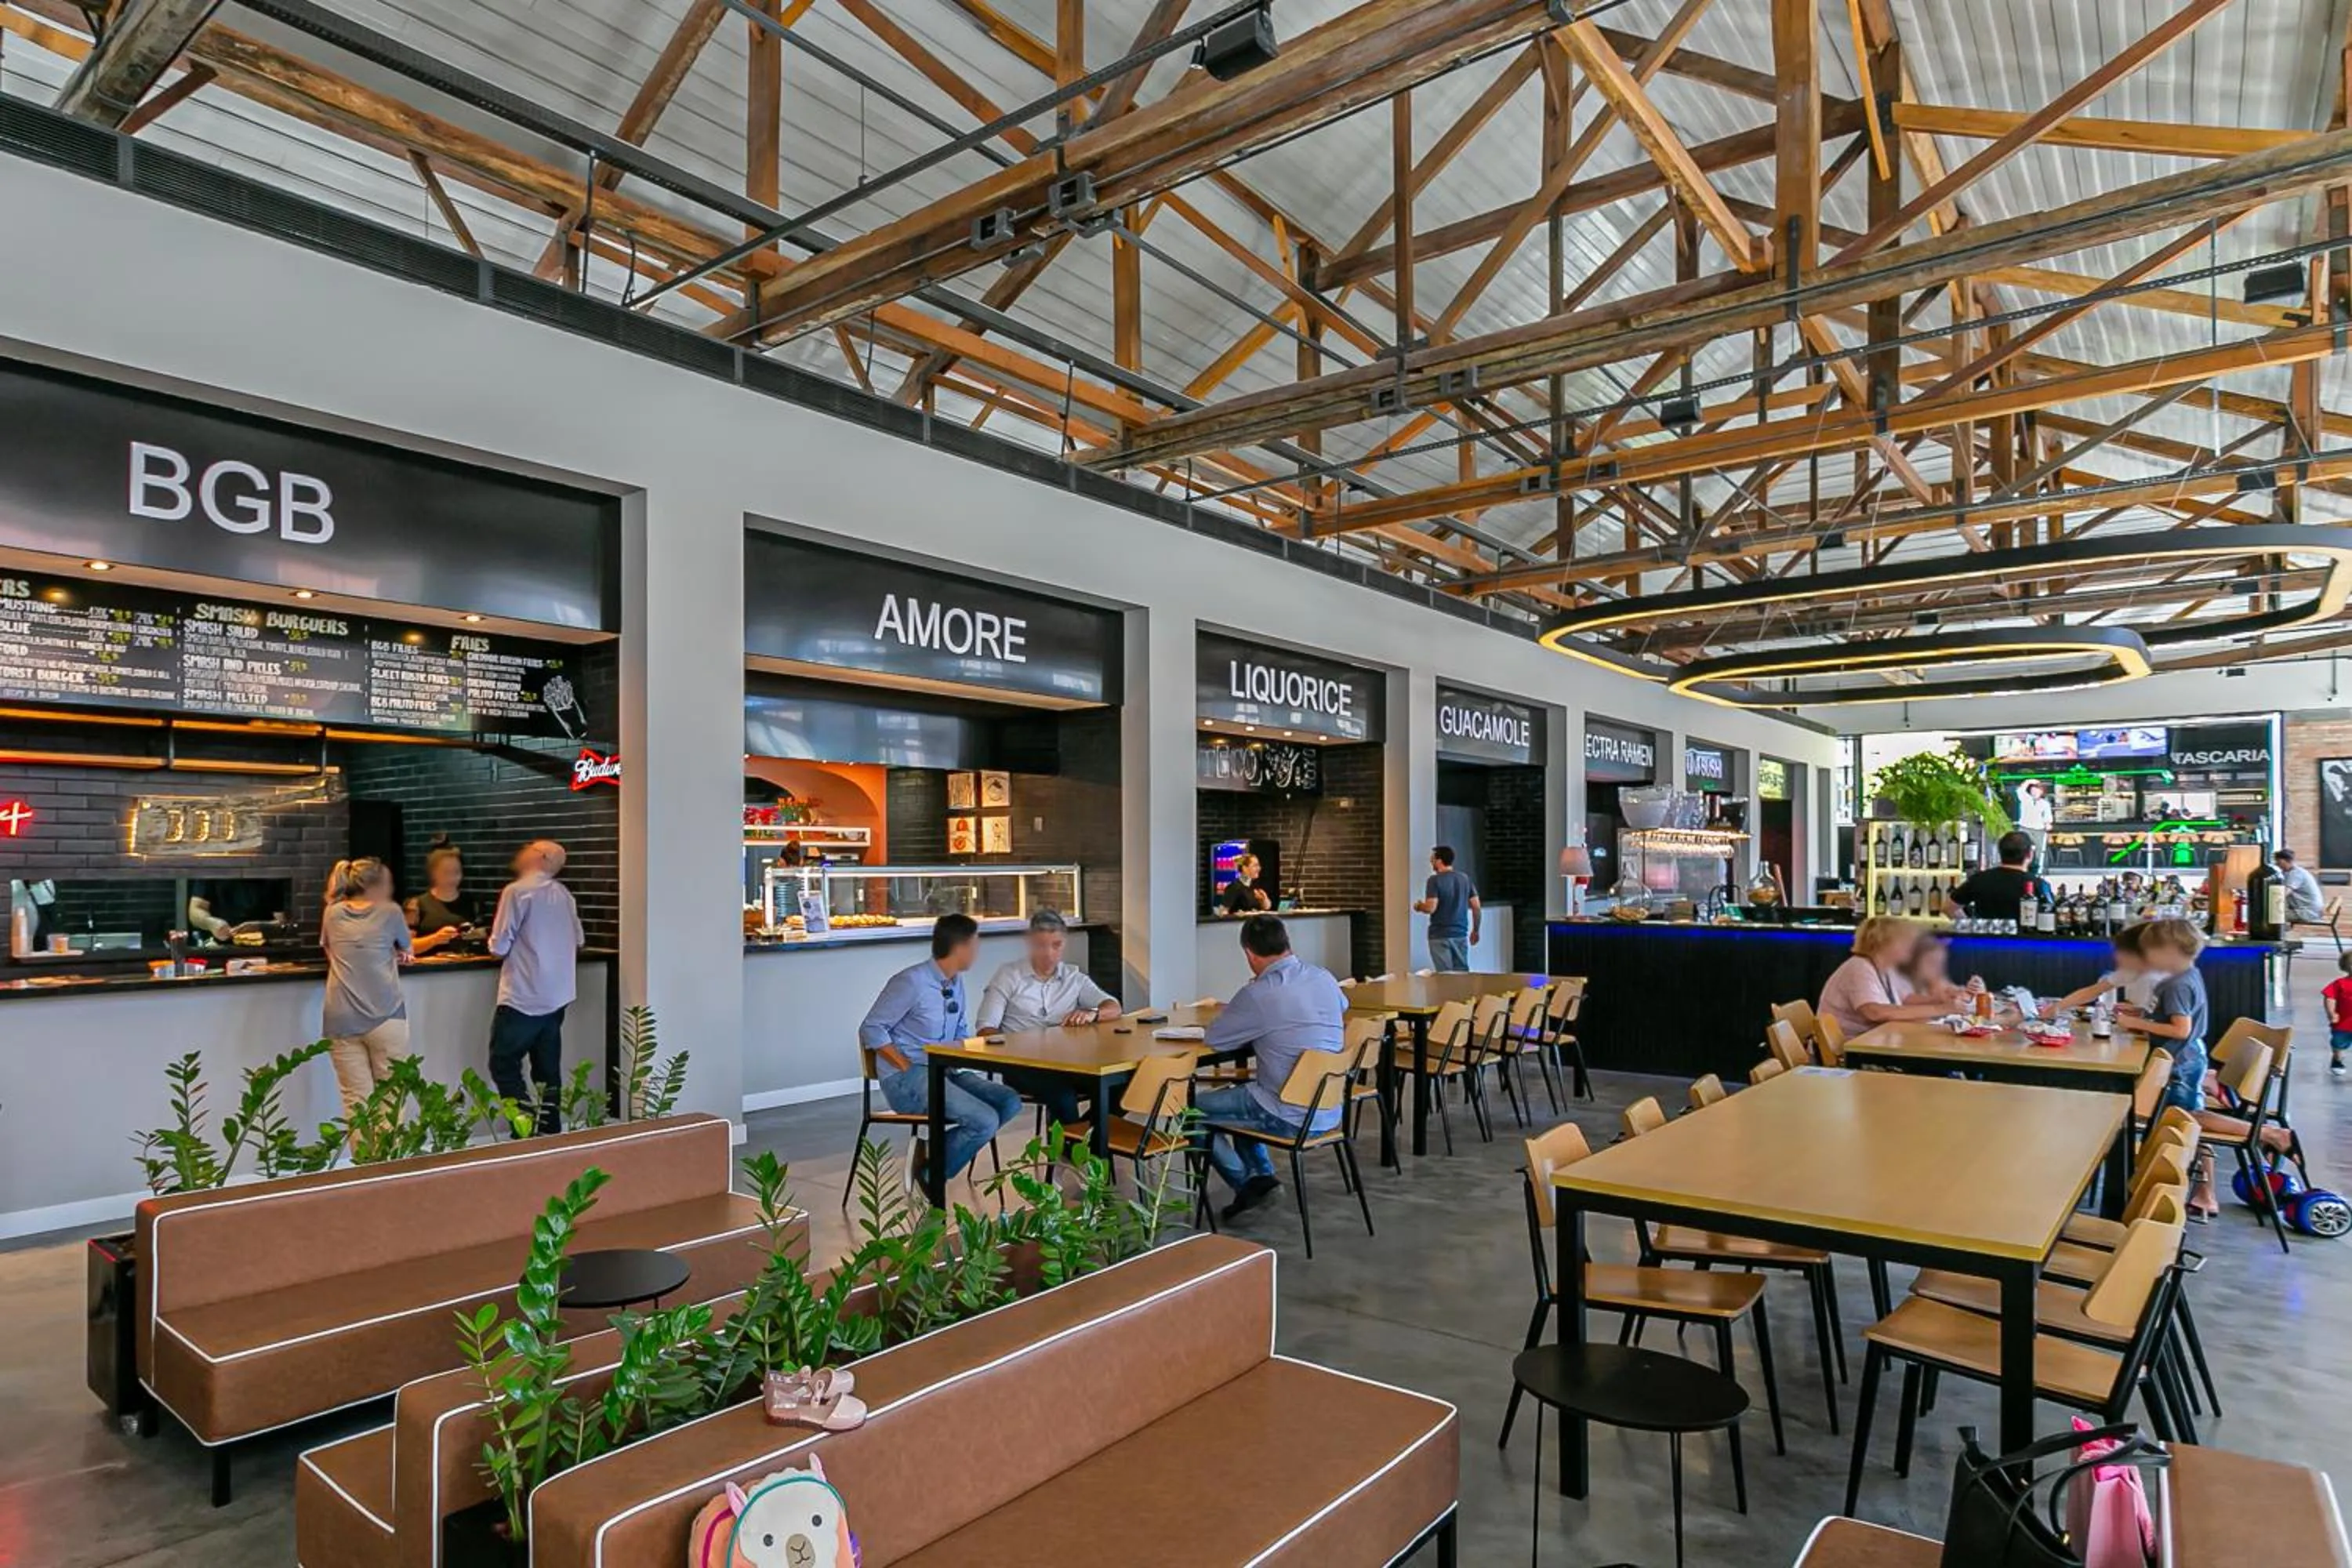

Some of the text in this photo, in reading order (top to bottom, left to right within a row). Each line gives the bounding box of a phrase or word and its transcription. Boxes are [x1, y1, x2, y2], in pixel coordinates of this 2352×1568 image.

[129, 441, 335, 543] BGB
[0, 578, 31, 598] RS
[183, 618, 223, 636] SMASH
[874, 593, 1026, 662] AMORE
[451, 635, 489, 652] FRIES
[183, 653, 220, 670] SMASH
[1230, 660, 1352, 717] LIQUORICE
[1440, 706, 1530, 746] GUACAMOLE
[1620, 739, 1653, 767] RAMEN
